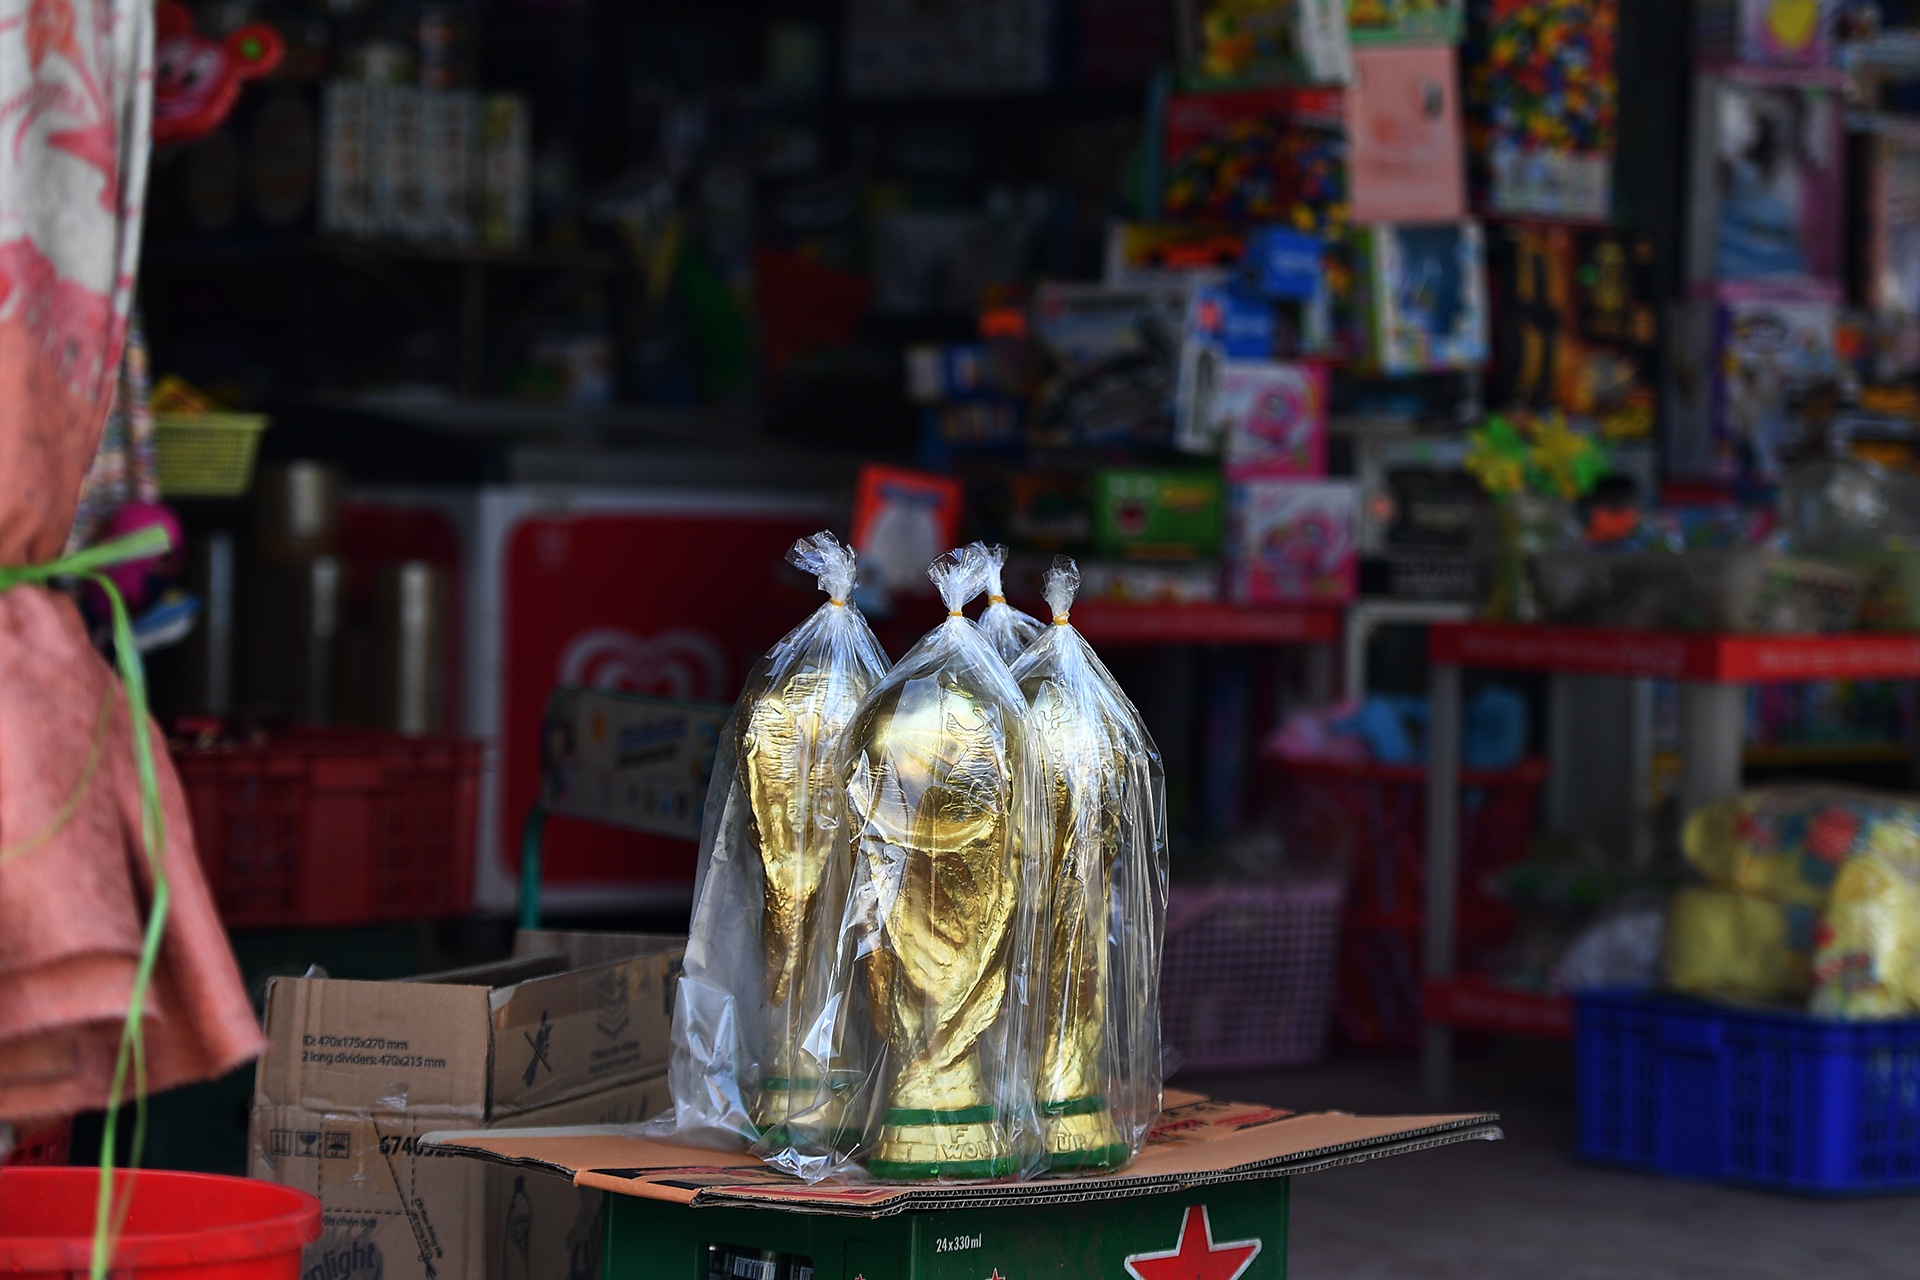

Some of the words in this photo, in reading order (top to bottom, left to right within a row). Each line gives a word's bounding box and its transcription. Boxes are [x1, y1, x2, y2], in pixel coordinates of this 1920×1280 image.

[317, 1036, 385, 1050] 470x175x270
[386, 1041, 408, 1050] mm
[302, 1051, 309, 1062] 2
[309, 1052, 333, 1065] long
[334, 1053, 377, 1065] dividers:
[378, 1055, 423, 1068] 470x215
[424, 1058, 446, 1068] mm
[380, 1136, 457, 1158] 6740
[303, 1241, 379, 1280] nlight
